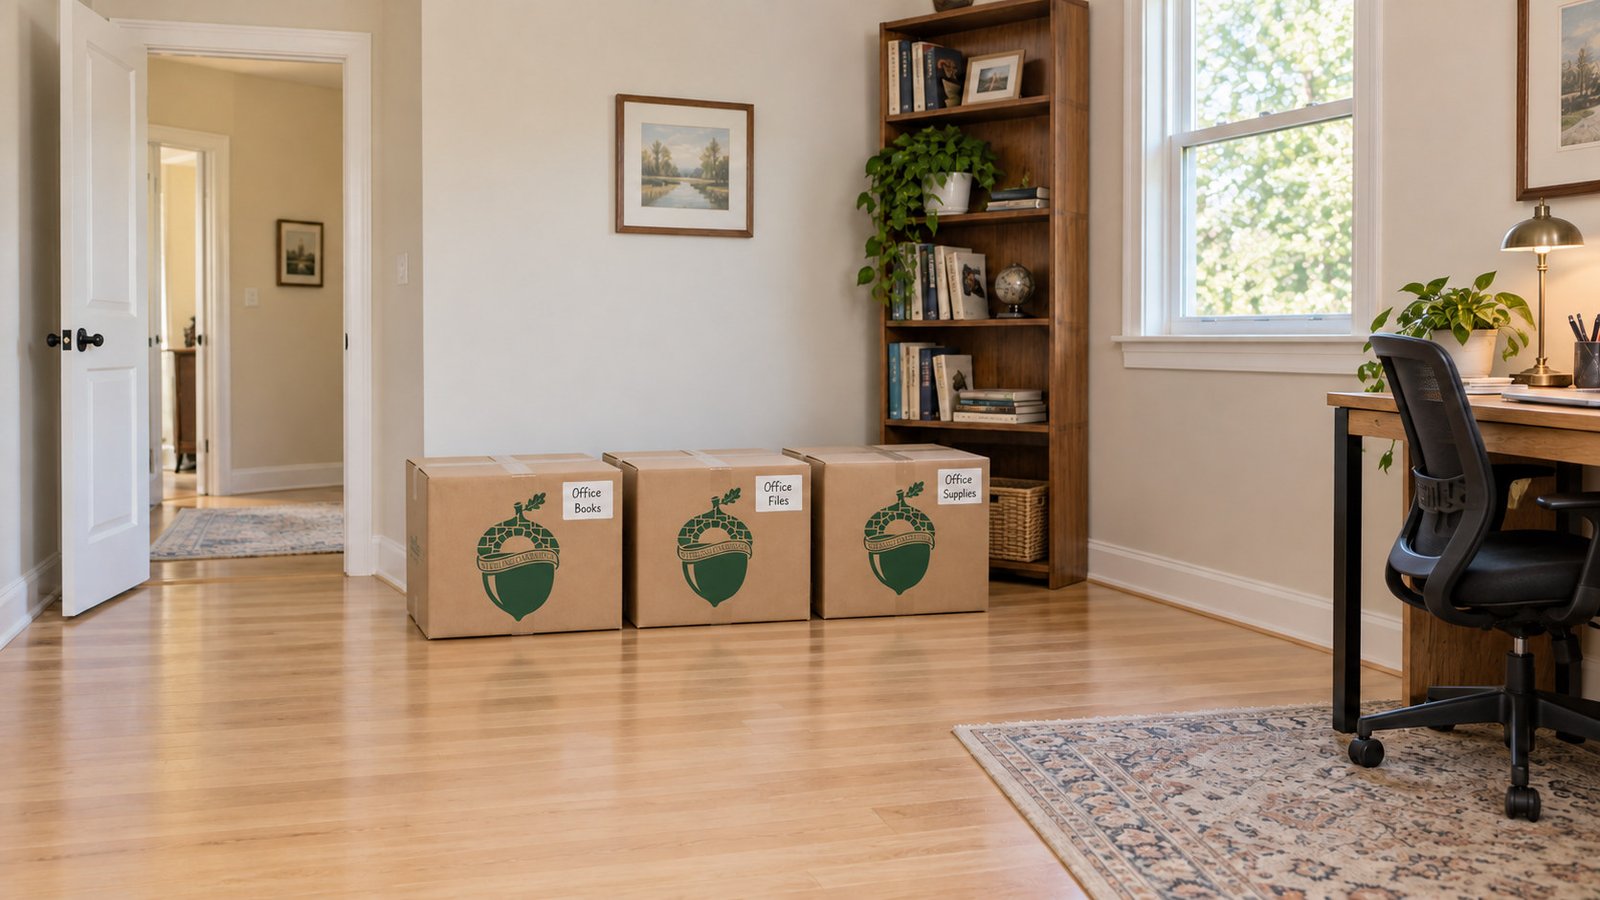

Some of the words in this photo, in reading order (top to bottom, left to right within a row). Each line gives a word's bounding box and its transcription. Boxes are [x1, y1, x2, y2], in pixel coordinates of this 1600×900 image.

[945, 473, 973, 485] Office
[572, 486, 602, 499] Office
[764, 480, 792, 493] Office
[768, 495, 790, 506] Files
[943, 488, 977, 501] Supplies
[574, 502, 602, 514] Books
